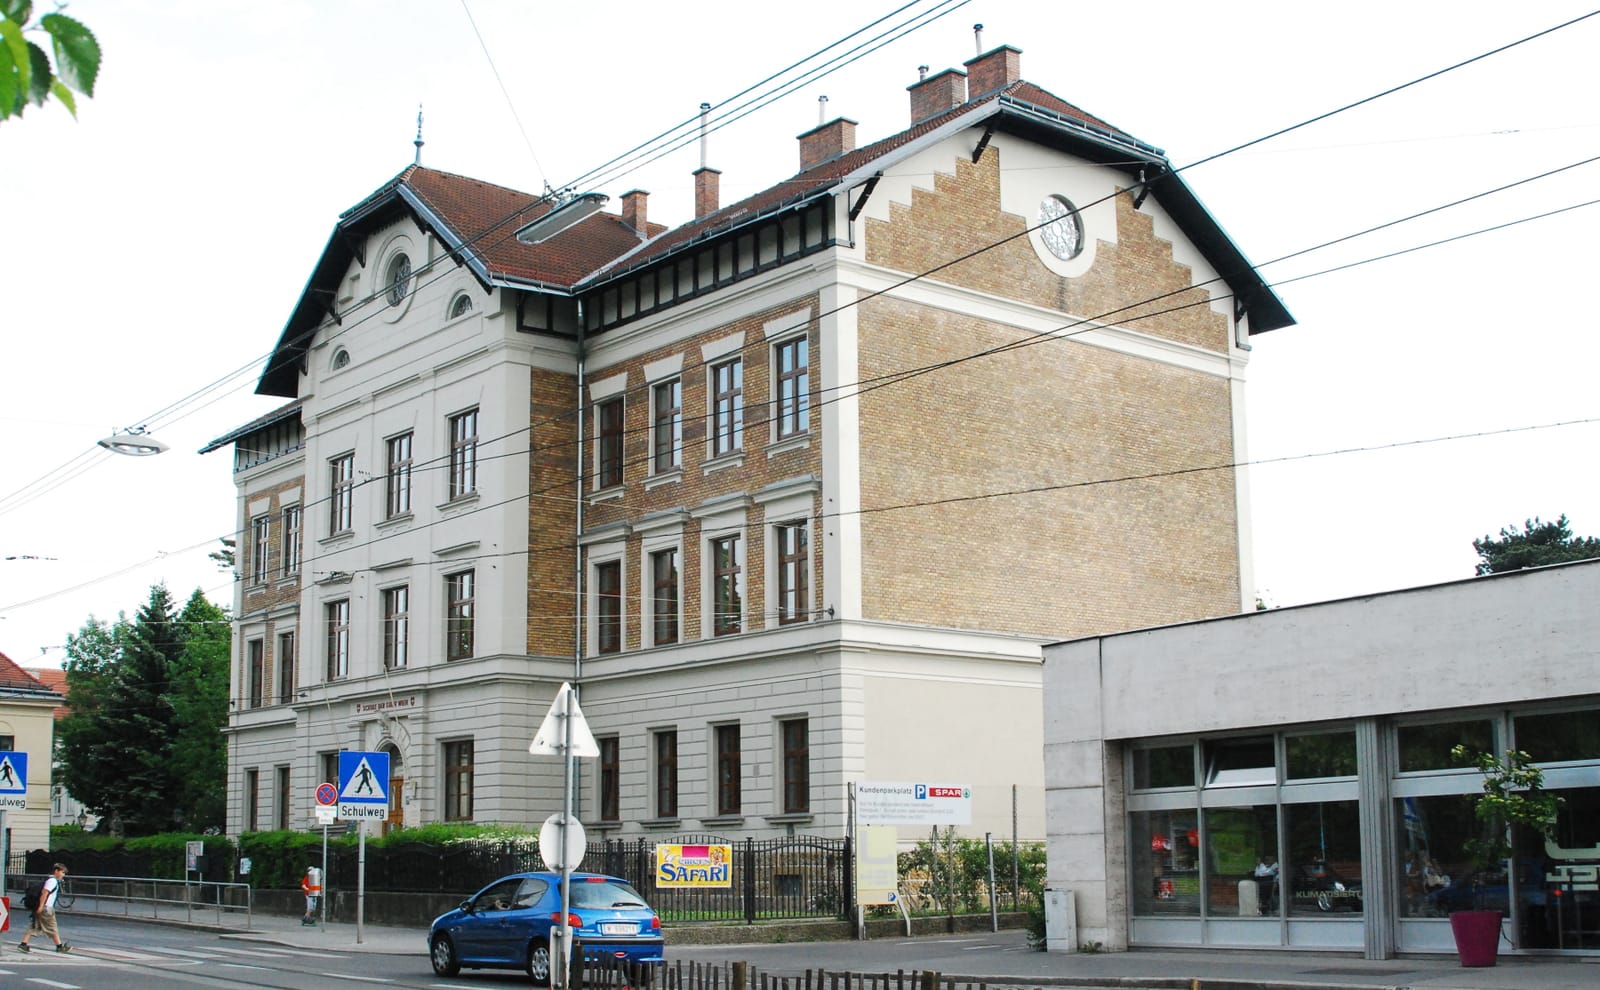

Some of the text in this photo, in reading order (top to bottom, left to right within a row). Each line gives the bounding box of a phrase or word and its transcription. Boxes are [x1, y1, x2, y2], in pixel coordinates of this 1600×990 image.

[859, 786, 912, 795] Kundenparkplatz
[935, 789, 961, 797] SPAR
[341, 805, 385, 820] Schulweg
[660, 863, 728, 882] SAFARI
